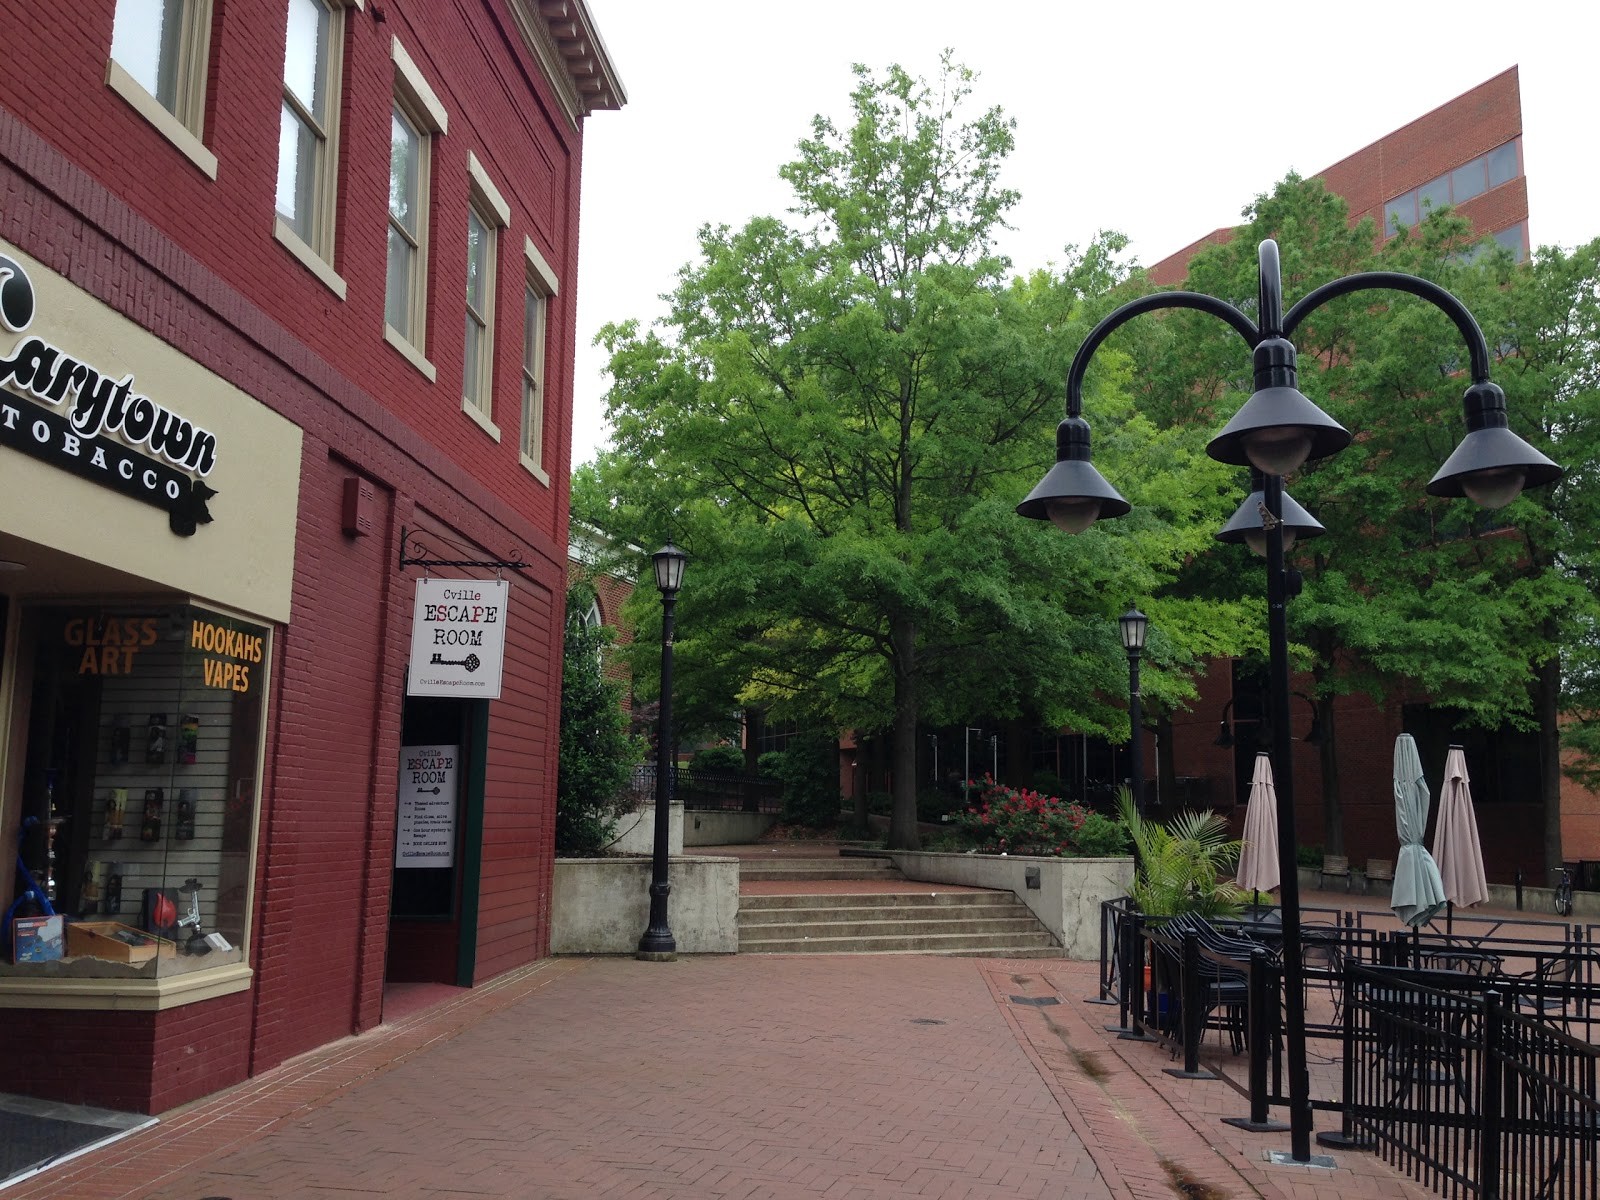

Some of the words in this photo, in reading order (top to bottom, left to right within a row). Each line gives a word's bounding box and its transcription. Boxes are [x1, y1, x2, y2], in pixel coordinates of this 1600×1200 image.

[2, 403, 181, 500] TOBACCO
[443, 589, 481, 601] Cville
[423, 604, 498, 623] ESCAPE
[64, 617, 158, 646] GLASS
[191, 619, 263, 663] HOOKAHS
[432, 628, 484, 646] ROOM
[79, 645, 140, 675] ART
[203, 658, 249, 694] VAPES
[419, 749, 441, 757] Cville
[406, 757, 453, 770] ESCAPE
[412, 771, 446, 784] ROOM
